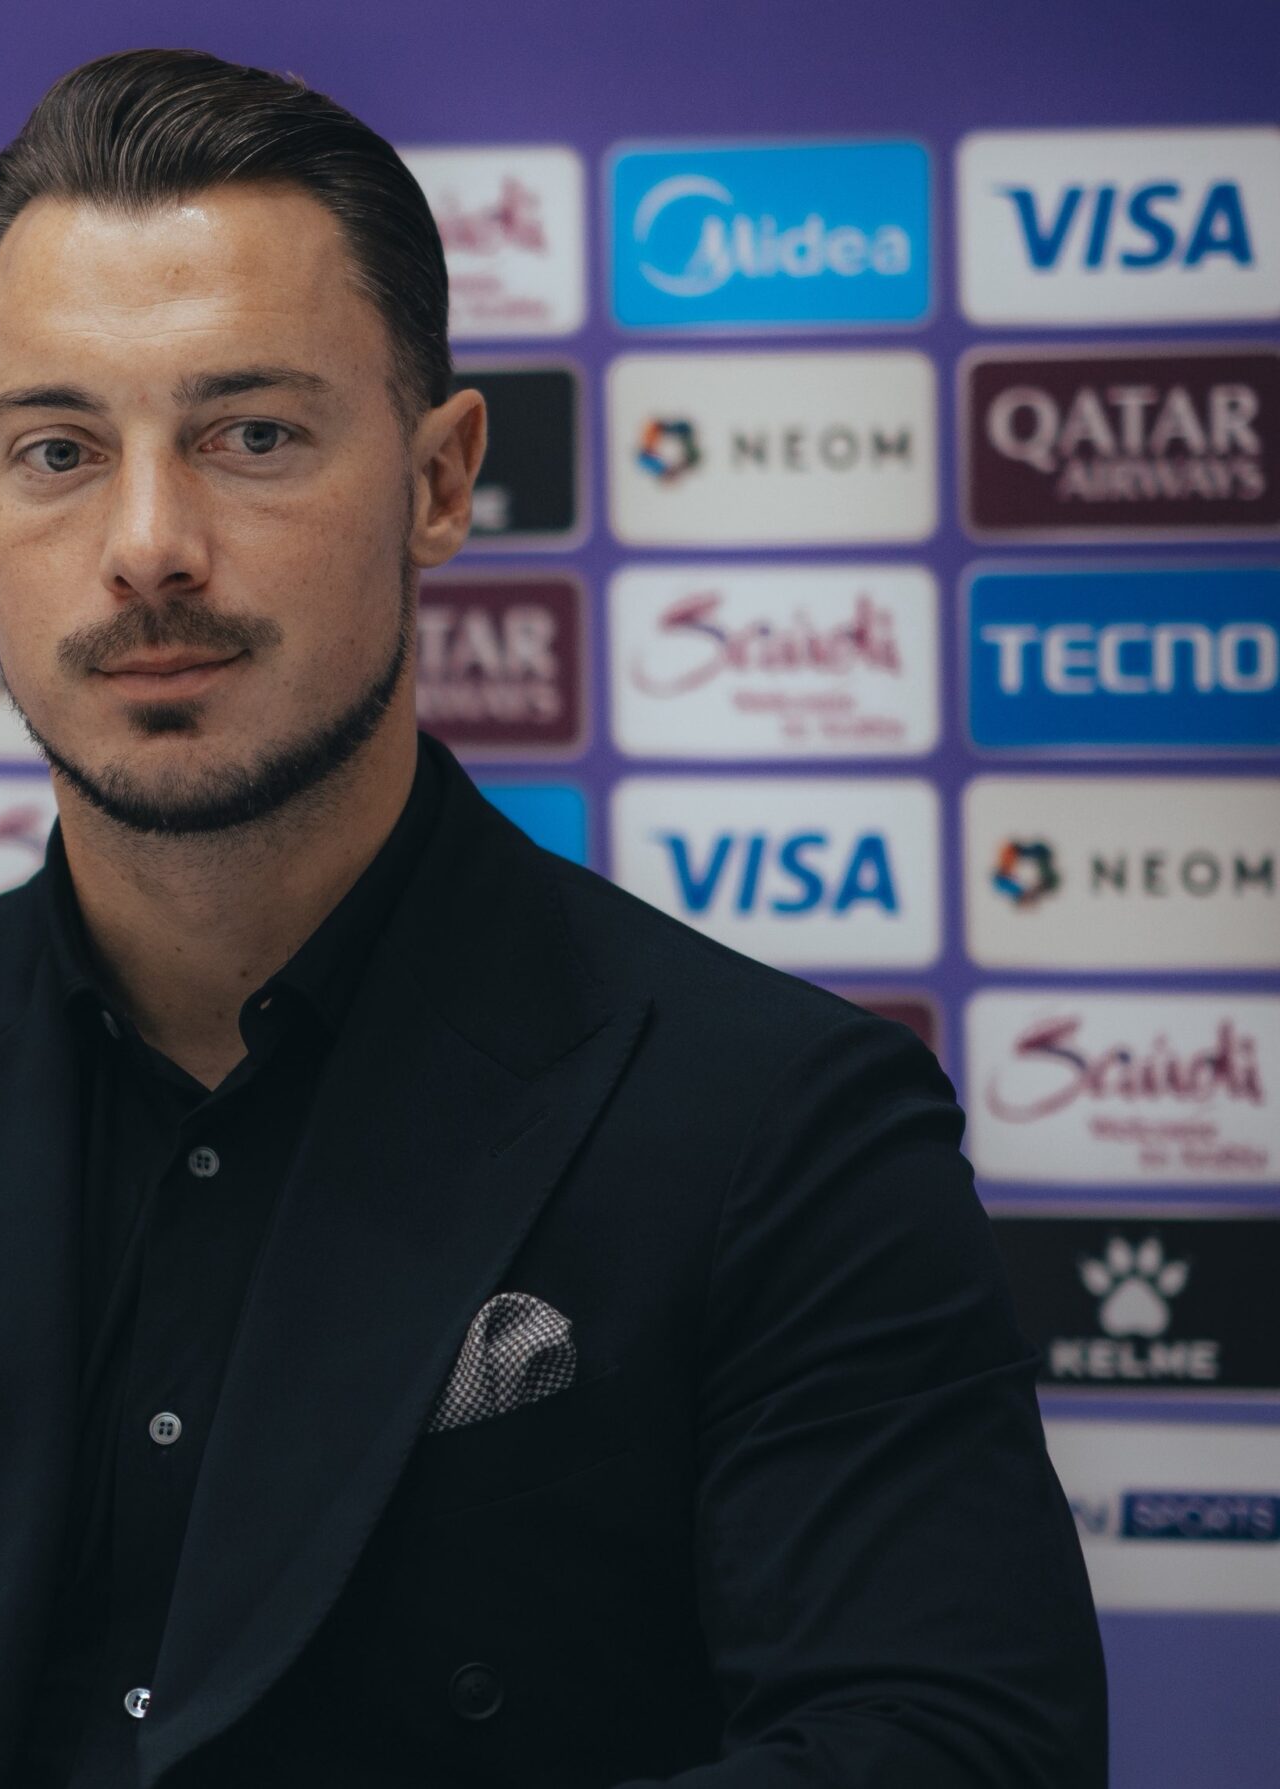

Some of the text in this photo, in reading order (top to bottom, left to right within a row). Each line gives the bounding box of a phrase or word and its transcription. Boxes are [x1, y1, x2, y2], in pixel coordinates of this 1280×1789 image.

[995, 179, 1257, 271] VISA
[728, 425, 914, 473] NEOM
[986, 383, 1263, 472] QATAR
[1056, 455, 1265, 502] AIRWAYS
[415, 605, 558, 684] TAR
[628, 588, 901, 699] Saudi
[980, 621, 1278, 696] TECNO
[654, 830, 901, 918] VISA
[1090, 850, 1278, 899] NEOM
[984, 1013, 1266, 1124] Saudi
[1048, 1337, 1221, 1381] KELME
